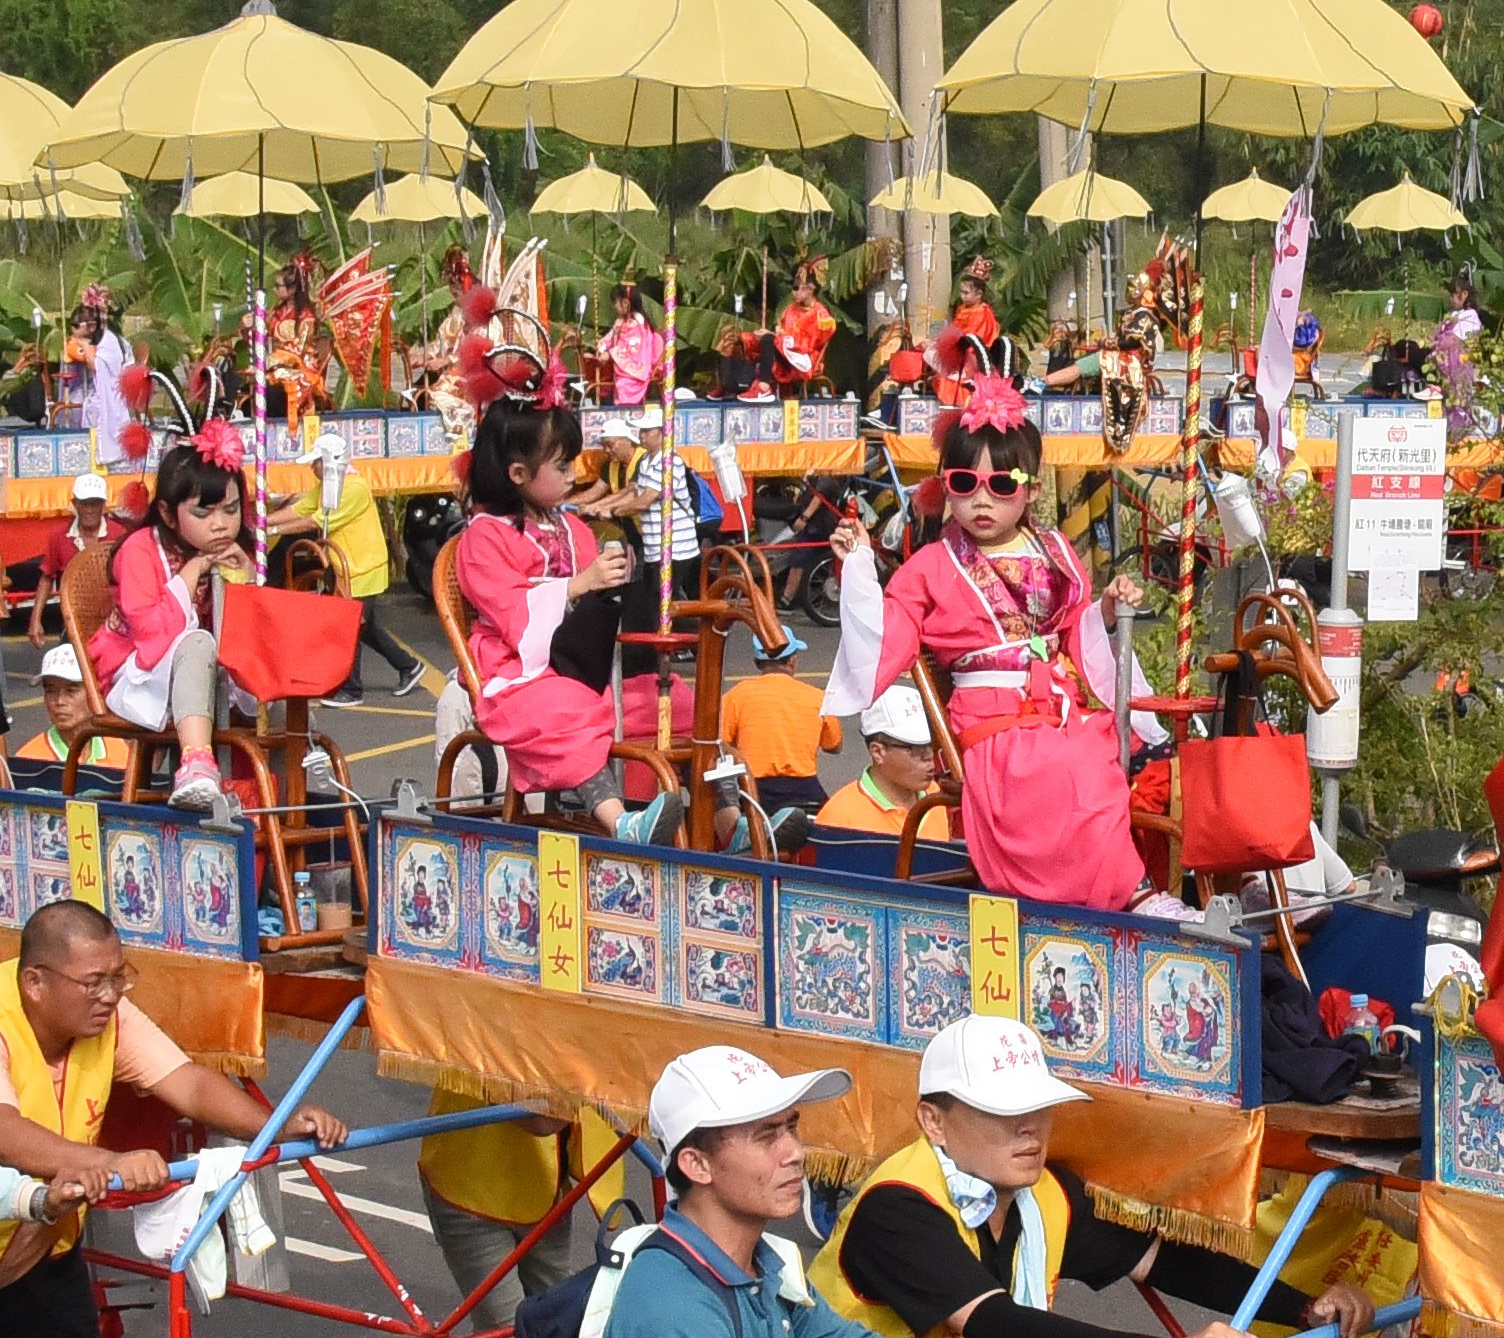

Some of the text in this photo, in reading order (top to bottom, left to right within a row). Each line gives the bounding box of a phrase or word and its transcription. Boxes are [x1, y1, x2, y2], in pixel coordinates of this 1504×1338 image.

[1357, 447, 1437, 464] 代天府(新光里)
[546, 860, 575, 977] 七仙女
